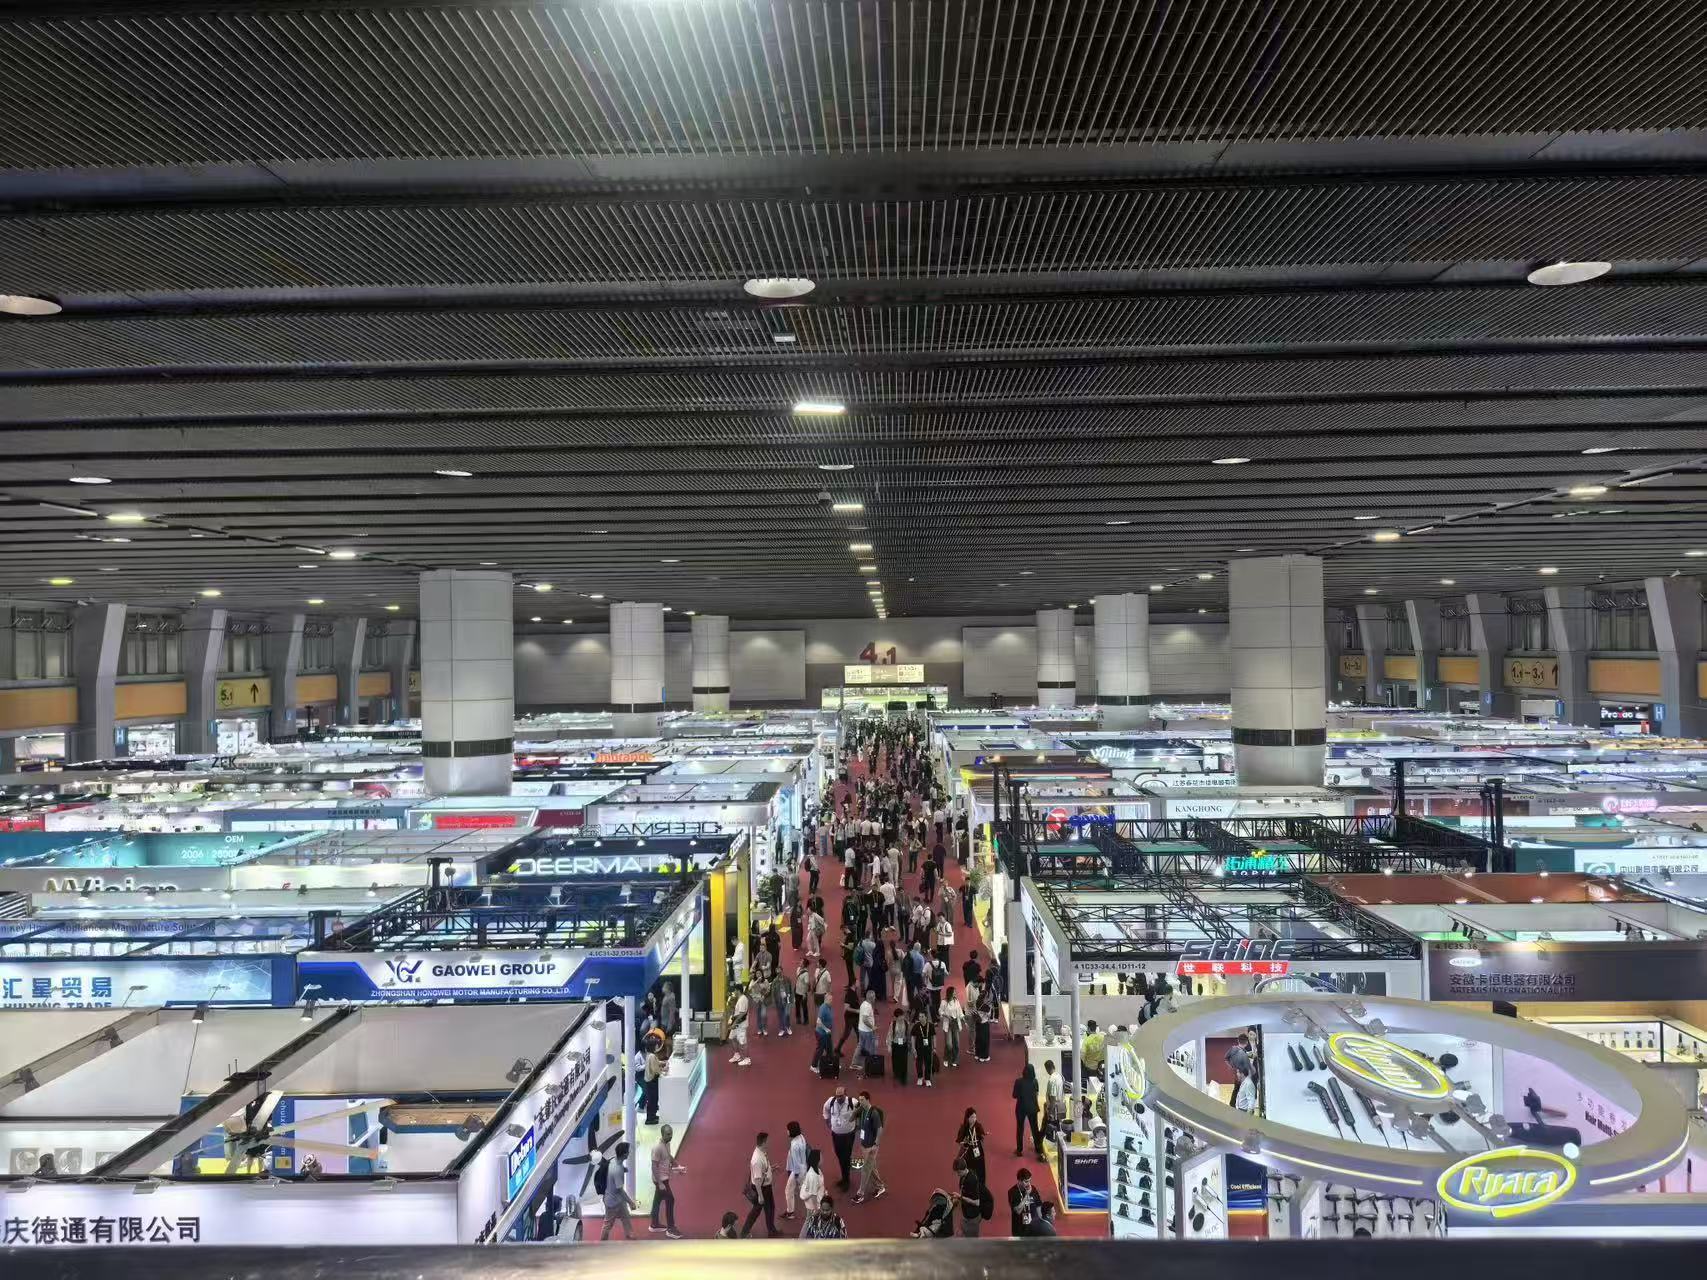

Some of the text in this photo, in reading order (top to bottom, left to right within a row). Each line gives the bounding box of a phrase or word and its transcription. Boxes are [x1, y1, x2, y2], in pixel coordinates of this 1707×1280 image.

[860, 641, 896, 665] 4.1
[221, 688, 233, 701] 5.1
[1655, 706, 1663, 719] H
[117, 730, 124, 743] H
[225, 835, 244, 843] OEM
[517, 857, 643, 876] DEERMA
[432, 963, 556, 977] GAOWEI GROUP
[1183, 962, 1283, 973] 世联科技
[2, 976, 112, 999] 汇星贸易
[371, 988, 416, 997] ZHONGSHAN
[417, 988, 452, 997] HONGWEI
[453, 988, 479, 996] MOTOR
[480, 987, 541, 996] MANUFACTURING
[0, 1216, 201, 1244] 庆德通有限公司
